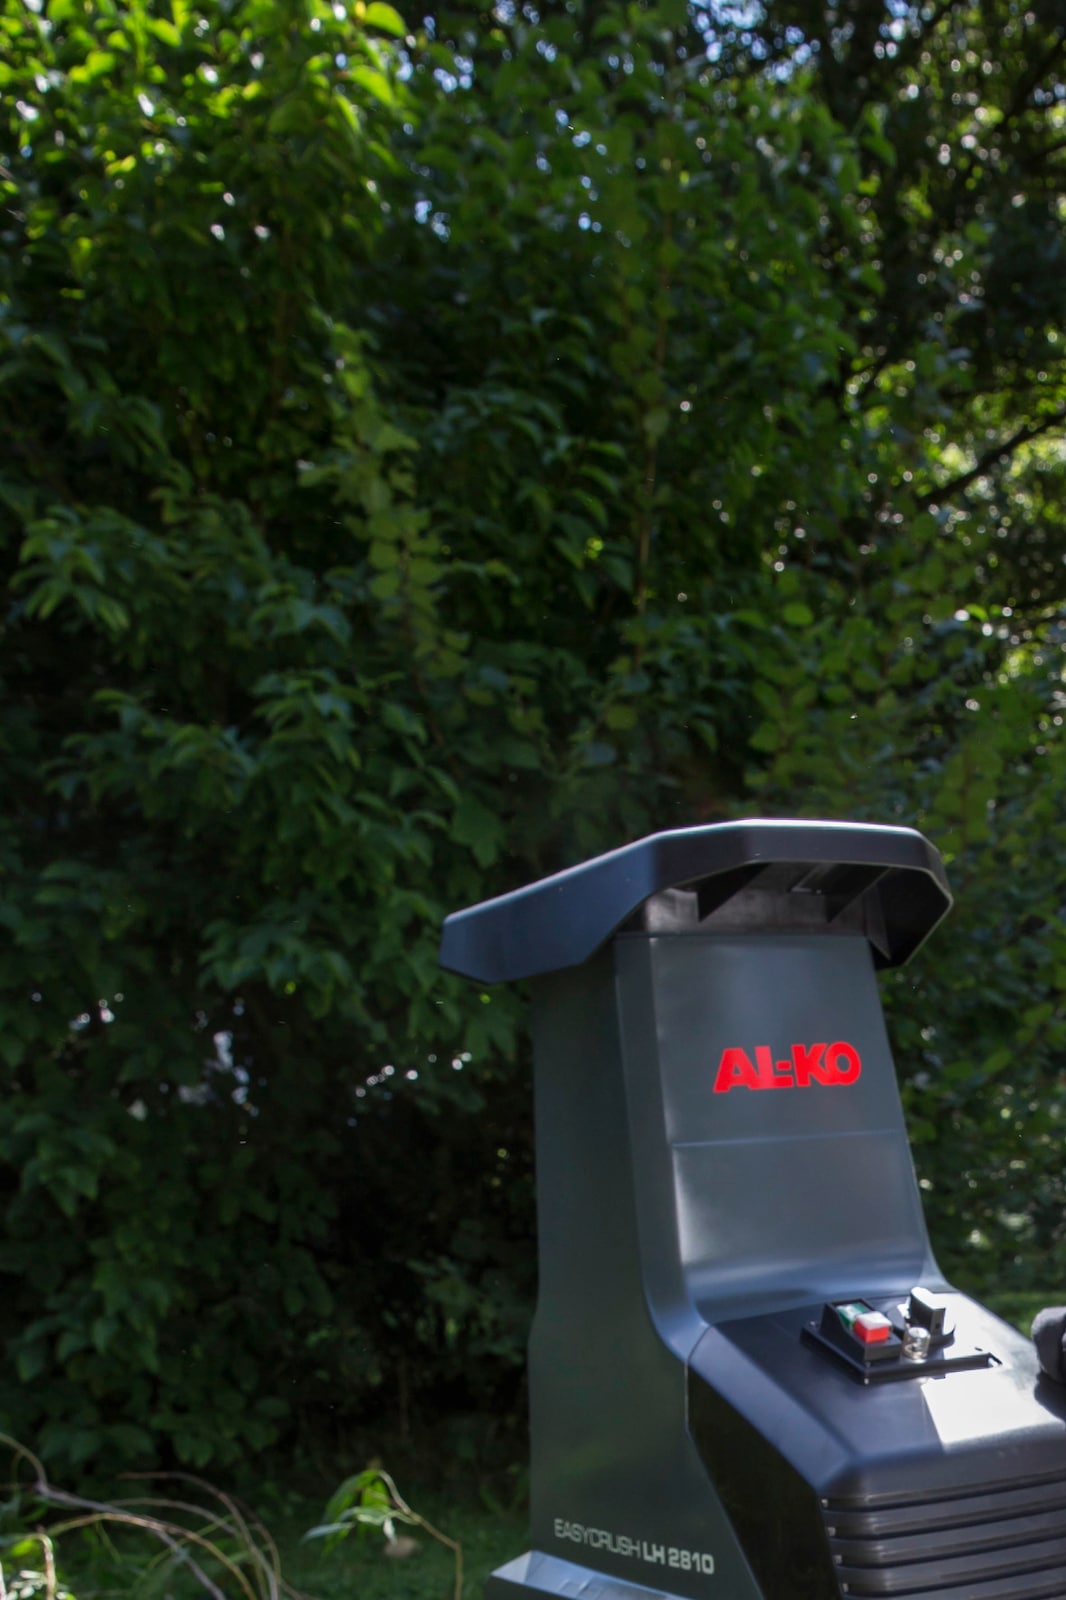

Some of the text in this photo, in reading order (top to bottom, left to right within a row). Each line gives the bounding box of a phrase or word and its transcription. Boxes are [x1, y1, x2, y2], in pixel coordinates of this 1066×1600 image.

[712, 1041, 862, 1094] AL-KO
[554, 1518, 715, 1575] EASYCRUSH LH 2810
